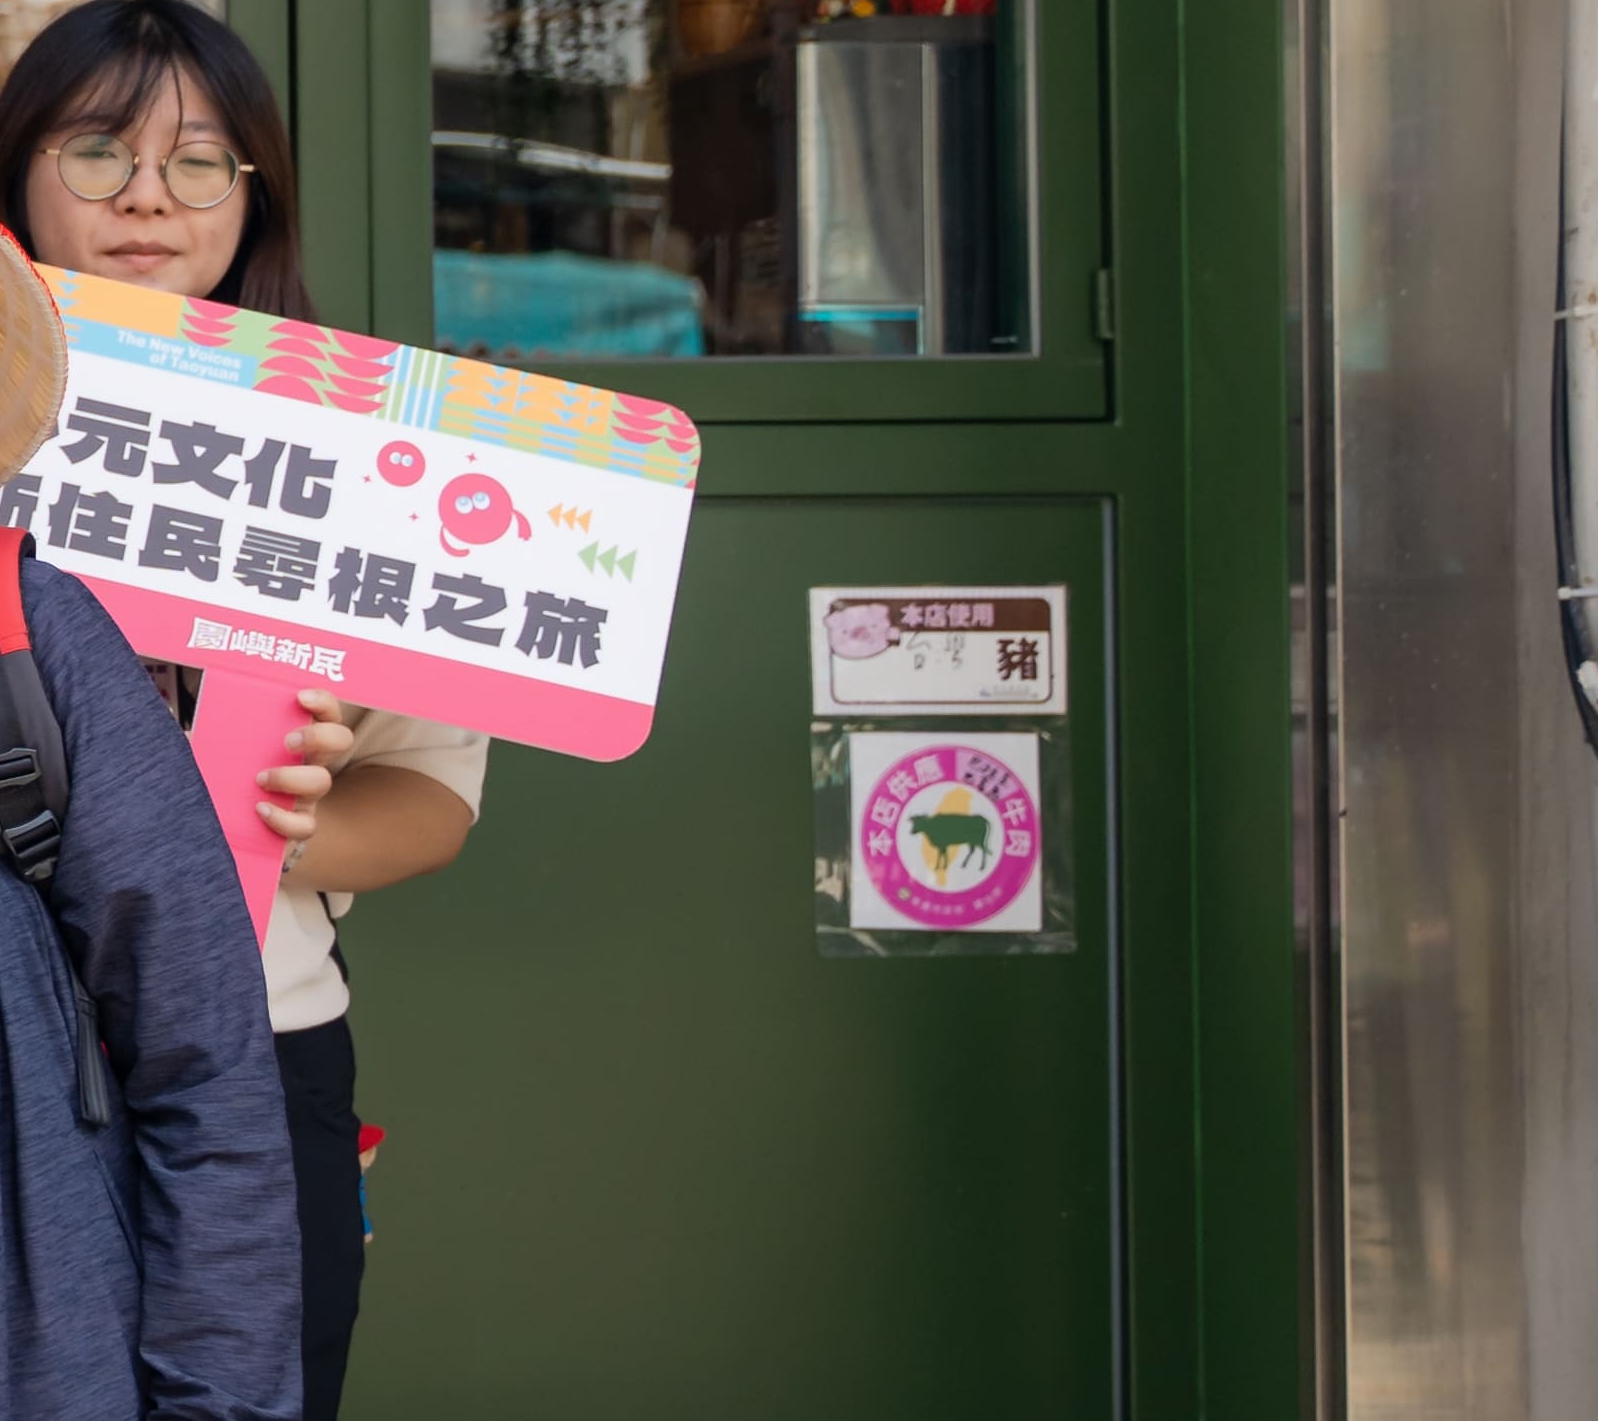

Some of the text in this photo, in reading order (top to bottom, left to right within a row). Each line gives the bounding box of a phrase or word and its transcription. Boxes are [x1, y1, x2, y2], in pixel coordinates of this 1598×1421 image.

[117, 330, 242, 369] The New Voices
[149, 352, 240, 382] of Taoyuan
[47, 395, 338, 520] 元文化
[901, 602, 995, 628] 本店使用
[997, 636, 1039, 680] 豬
